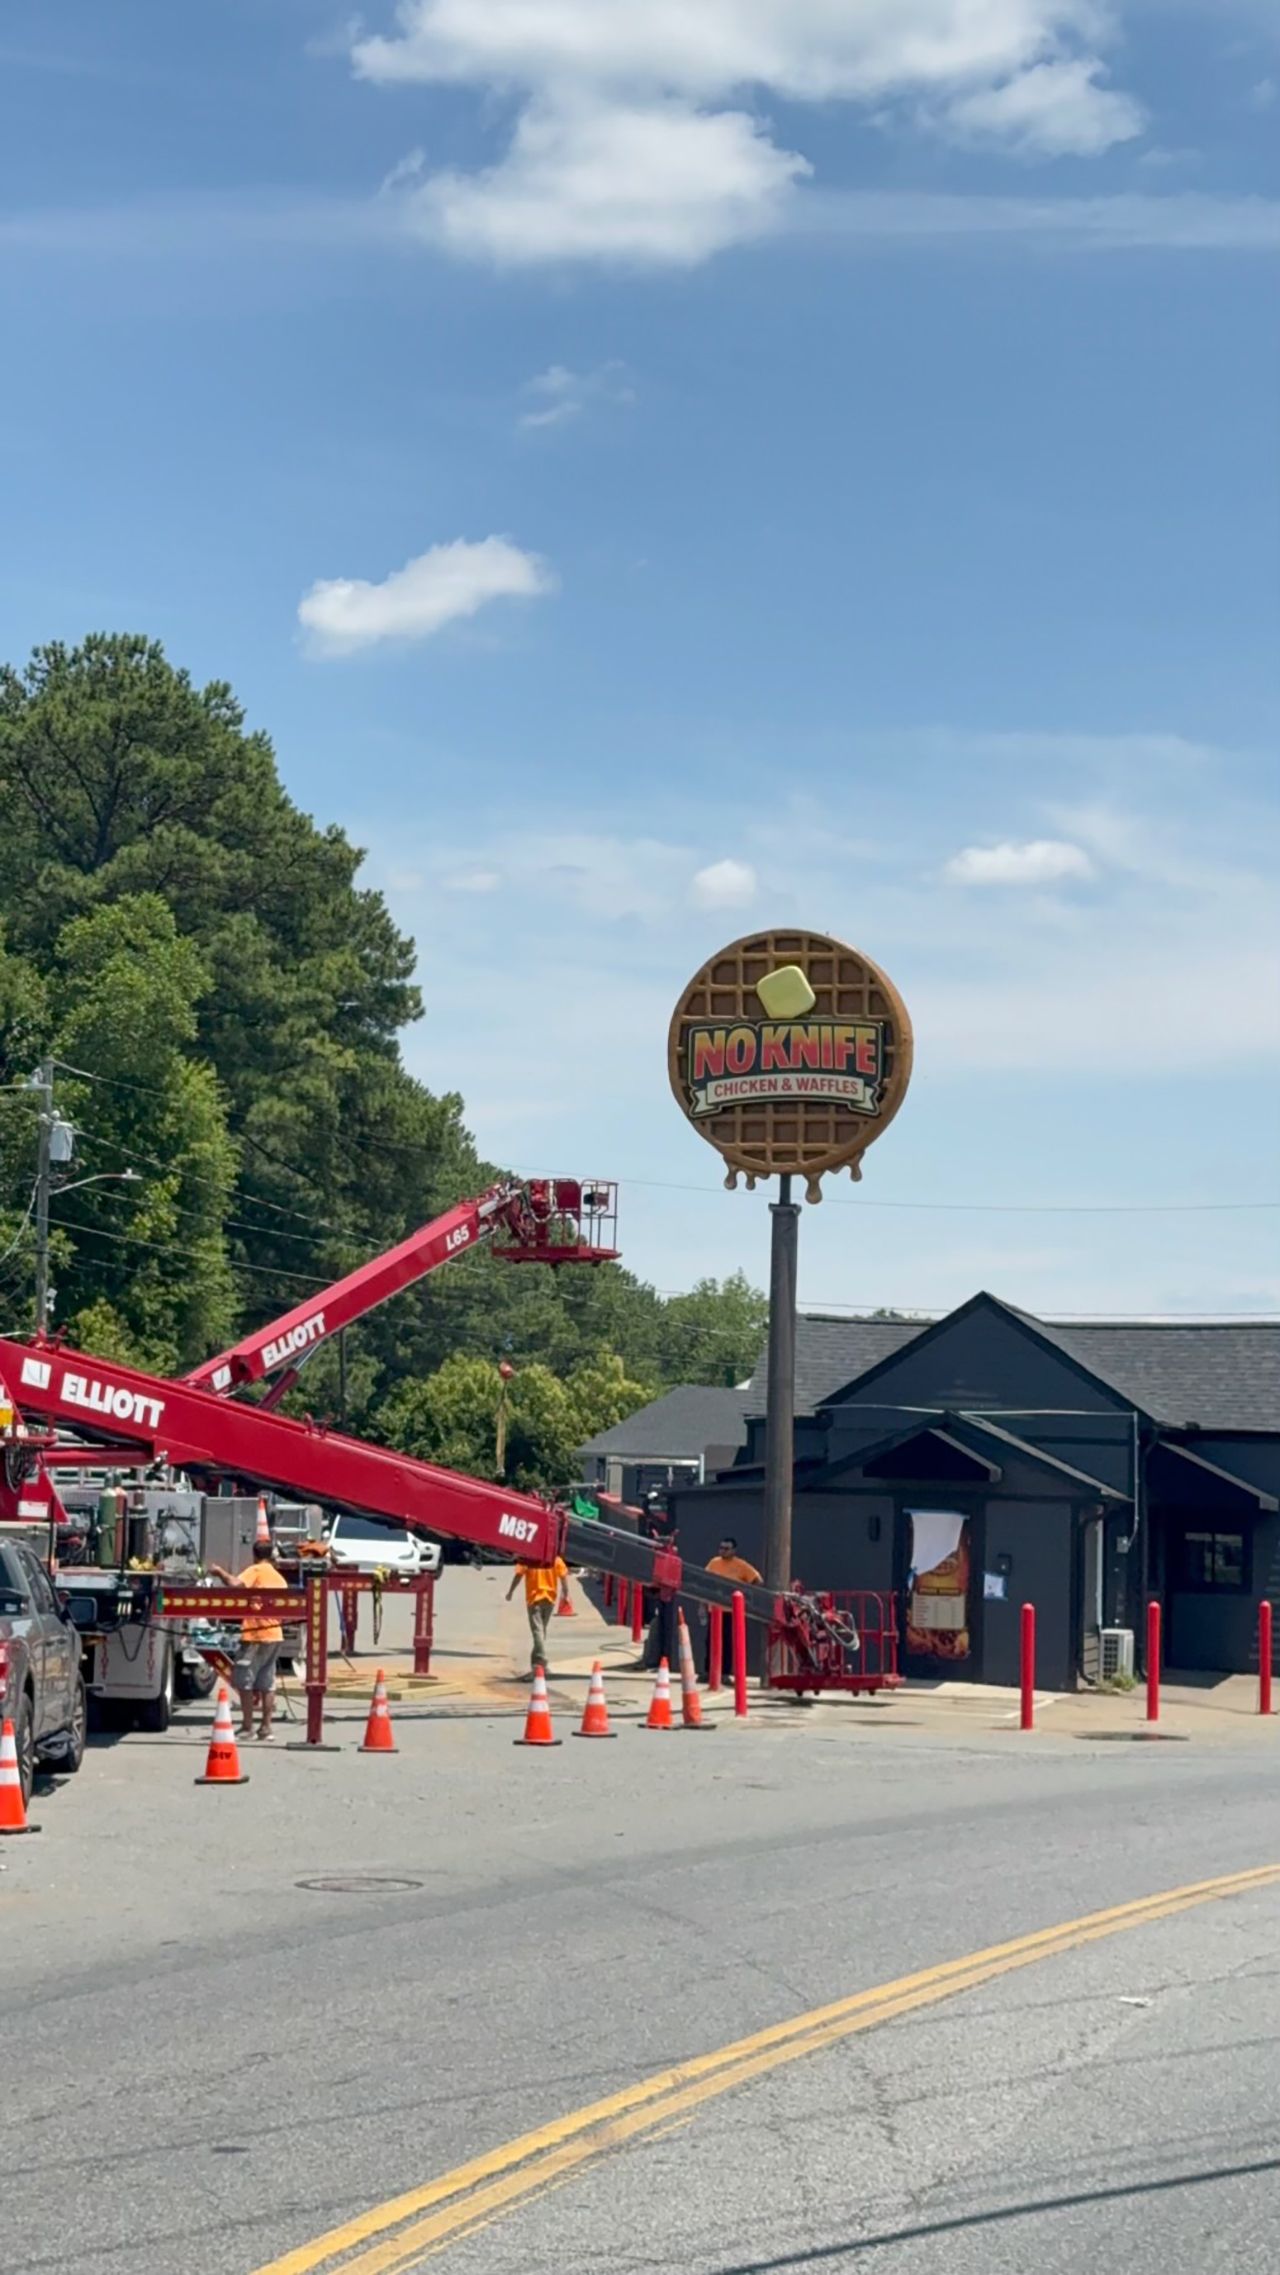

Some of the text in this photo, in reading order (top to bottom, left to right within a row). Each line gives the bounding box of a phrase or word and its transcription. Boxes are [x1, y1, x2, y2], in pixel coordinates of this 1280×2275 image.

[693, 1024, 877, 1080] NO KNIFE
[714, 1077, 858, 1097] CHICKEN & WAFFLES
[446, 1225, 470, 1251] L65
[261, 1312, 326, 1369] ELLIOTT
[60, 1372, 166, 1428] ELLIOTT
[498, 1513, 539, 1543] M87
